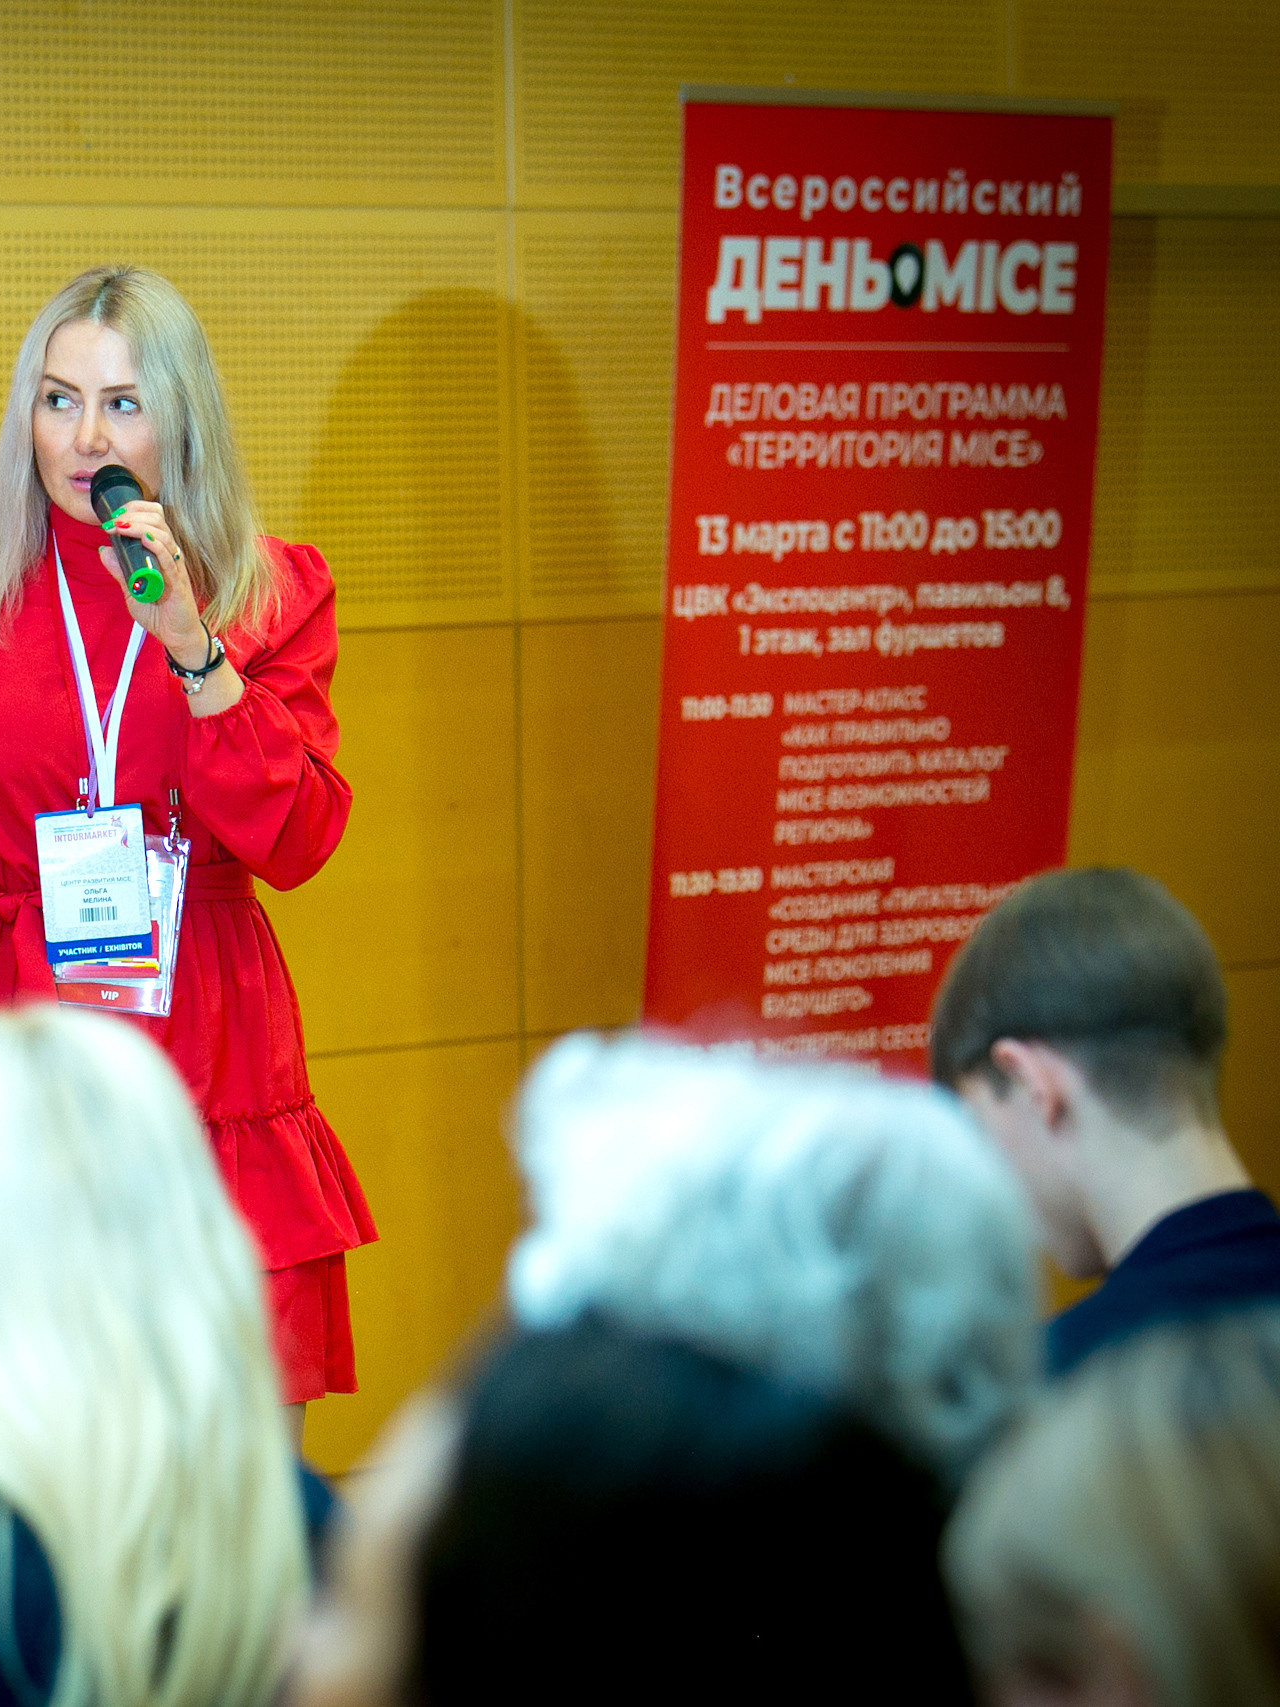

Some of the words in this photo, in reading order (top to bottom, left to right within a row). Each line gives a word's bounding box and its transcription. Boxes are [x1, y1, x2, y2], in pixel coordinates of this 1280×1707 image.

[714, 164, 1082, 220] Всероссийский
[706, 236, 893, 324] ДЕНЬ
[922, 240, 1078, 315] MICE
[705, 382, 860, 426] ДЕЛОВАЯ
[866, 381, 1067, 420] ПРОГРАММА
[727, 431, 943, 469] «ТЕРРИТОРИЯ
[950, 429, 1044, 467] MICE»
[697, 514, 729, 555] 13
[732, 519, 828, 561] марта
[834, 519, 856, 551] с
[859, 511, 928, 550] 11:00
[930, 517, 978, 555] до
[982, 508, 1062, 550] 15:00
[673, 583, 728, 621] ЦВК
[54, 828, 118, 843] INTOURMARKET
[83, 896, 112, 904] МЕЛИНА
[84, 887, 108, 895] ОЛЬГА
[58, 946, 97, 957] УЧАСТНИК
[105, 942, 143, 953] EXHIBITOR
[101, 990, 119, 1001] VIP
